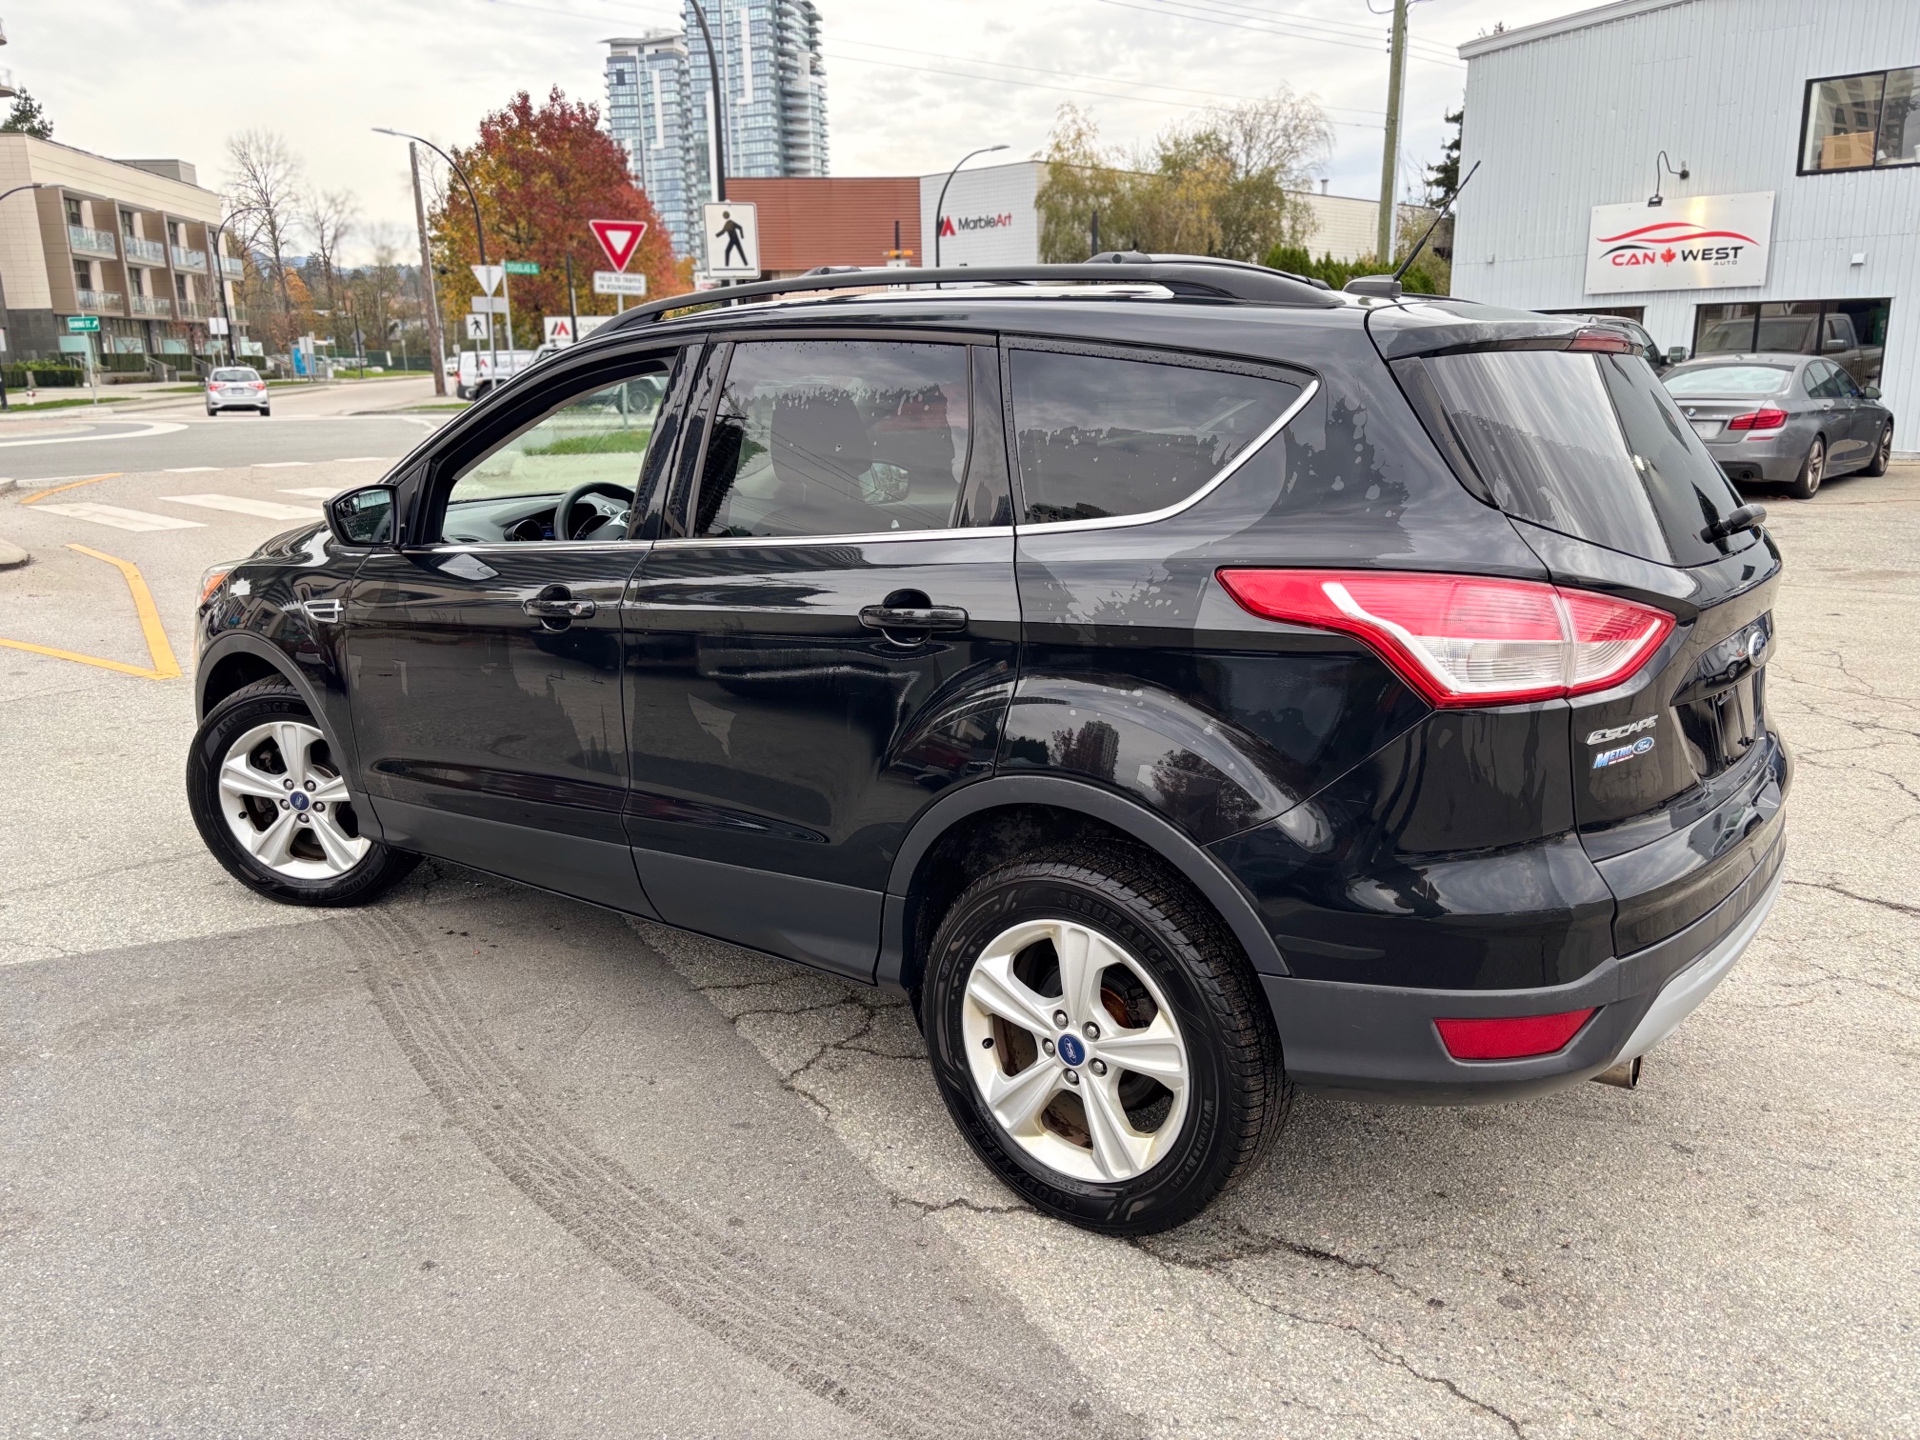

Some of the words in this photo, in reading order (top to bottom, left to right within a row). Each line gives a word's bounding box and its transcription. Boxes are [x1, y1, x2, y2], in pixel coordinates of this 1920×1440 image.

[958, 212, 1012, 231] MarbleArt
[1612, 252, 1656, 266] CAN
[1681, 246, 1745, 262] WEST
[1585, 714, 1658, 746] ESCAPE
[1592, 744, 1633, 769] METRO
[1056, 891, 1174, 975] ASSURANCE
